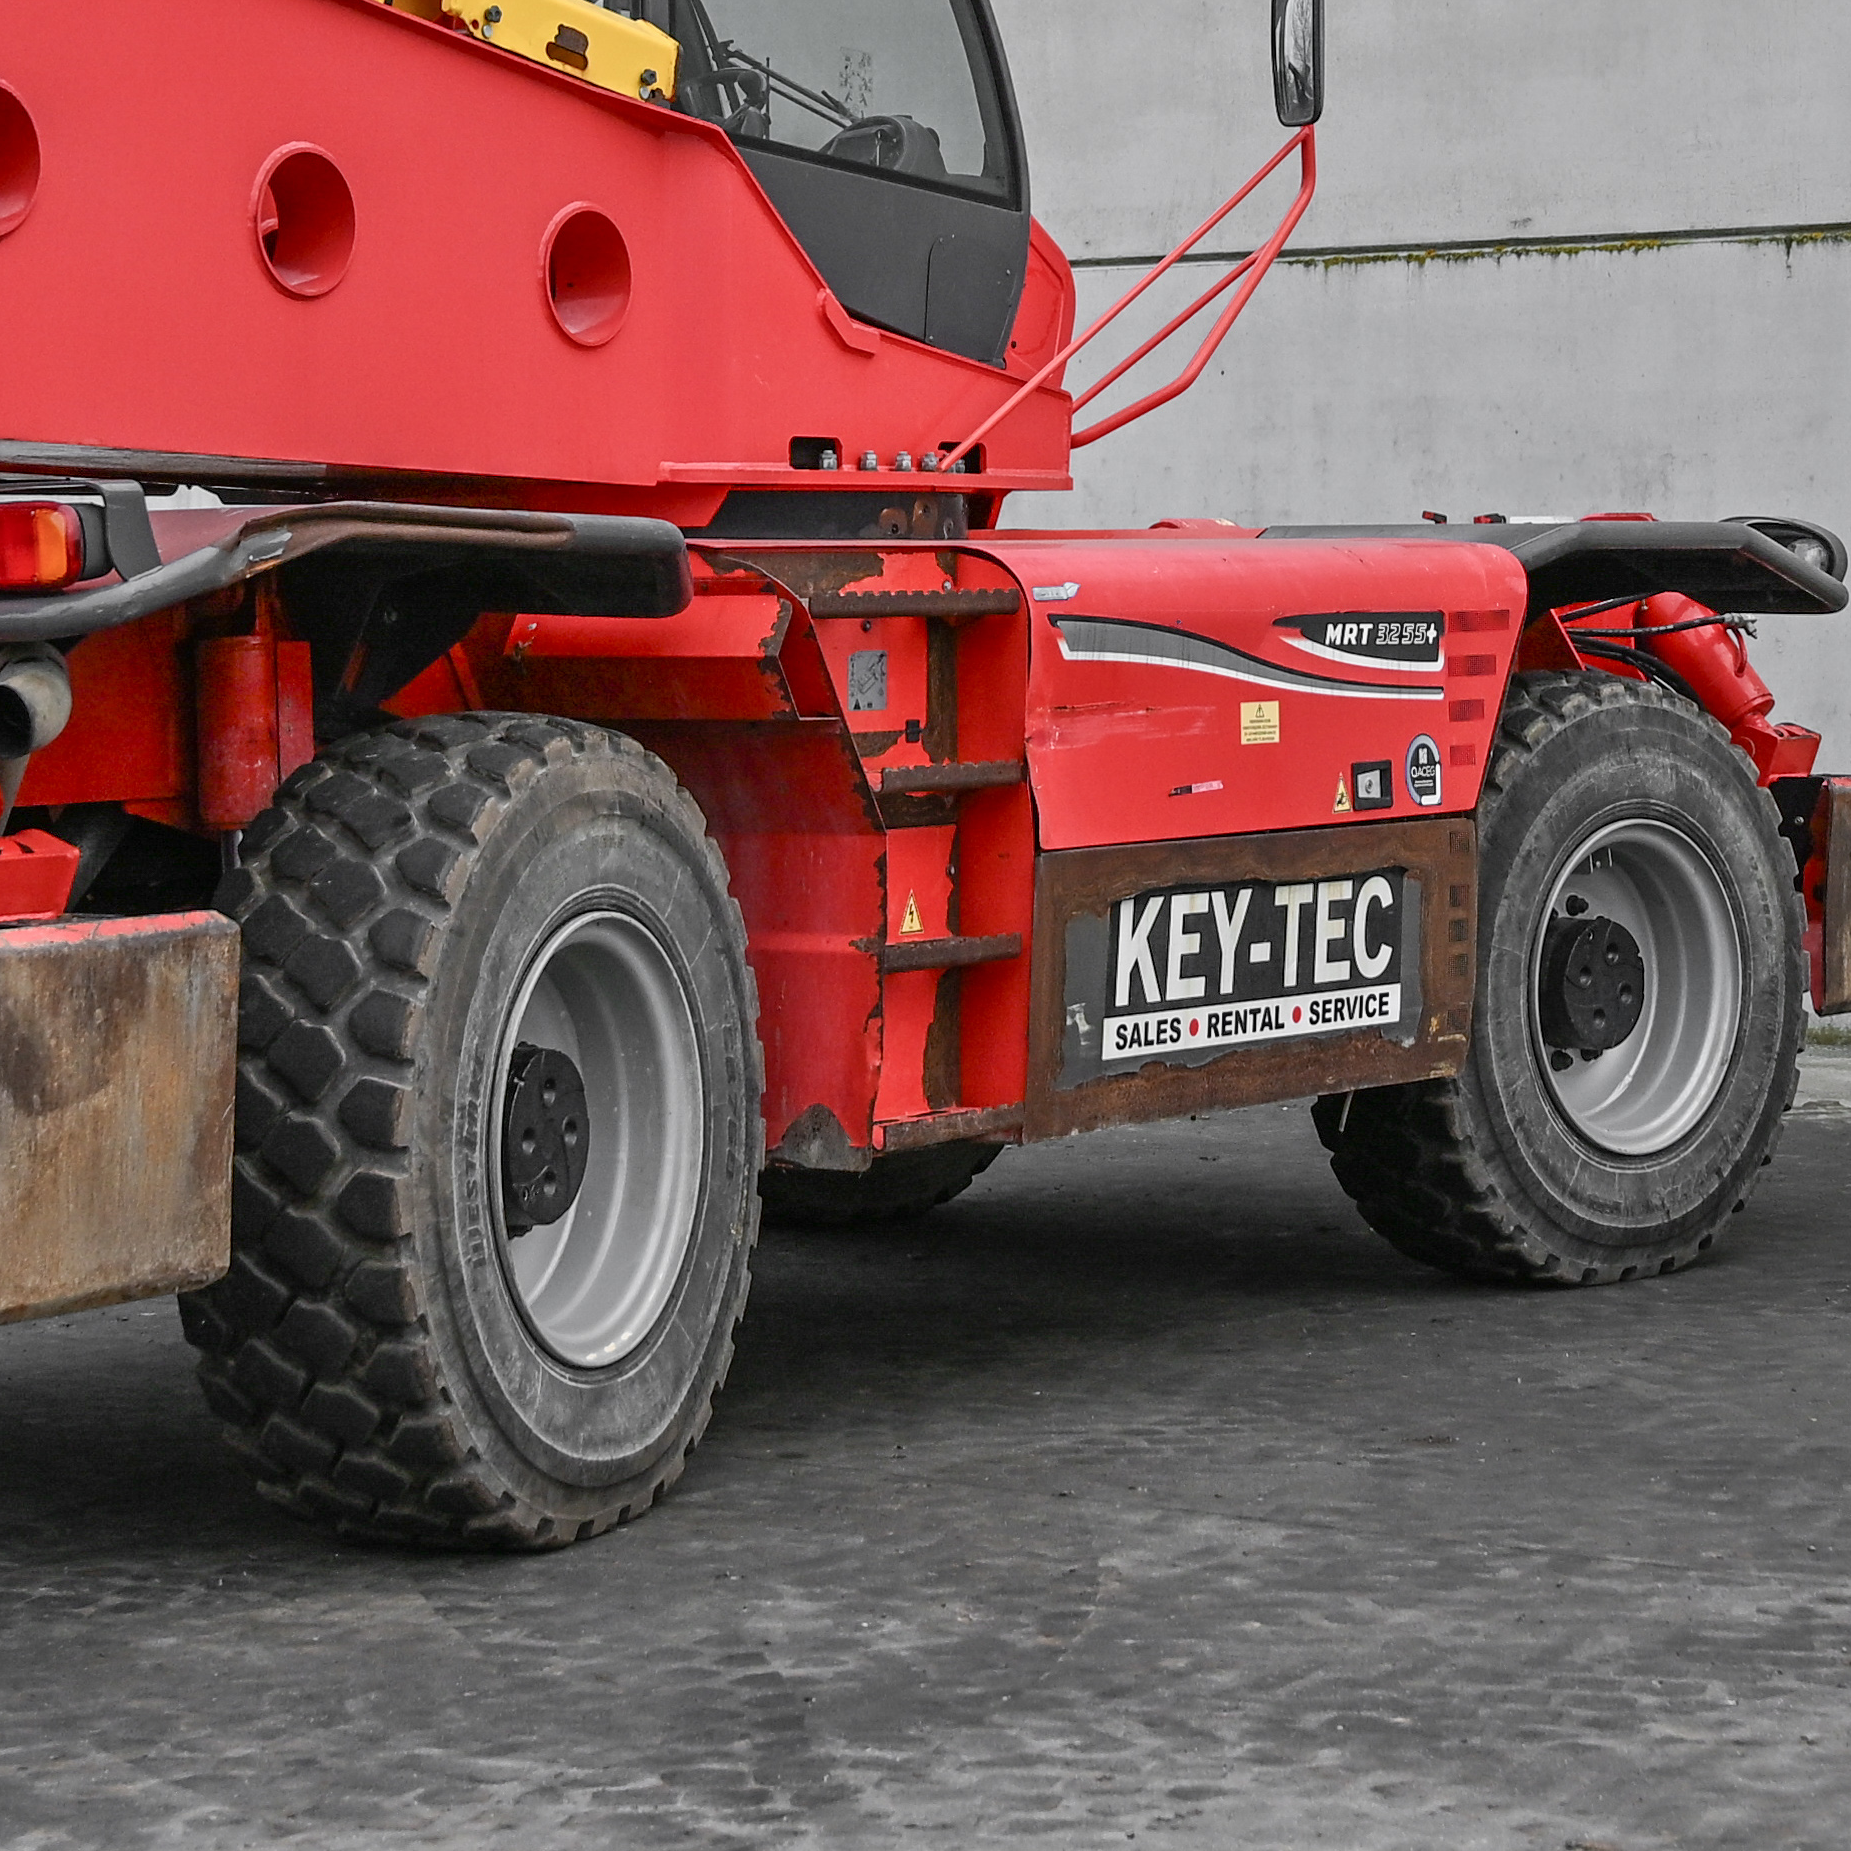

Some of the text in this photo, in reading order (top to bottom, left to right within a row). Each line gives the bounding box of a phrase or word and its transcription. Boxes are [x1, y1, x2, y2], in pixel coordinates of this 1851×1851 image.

[1324, 623, 1374, 646] MRT
[1114, 875, 1394, 1008] KEY-TEC
[1115, 991, 1390, 1051] SALES RENTAL SERVICE
